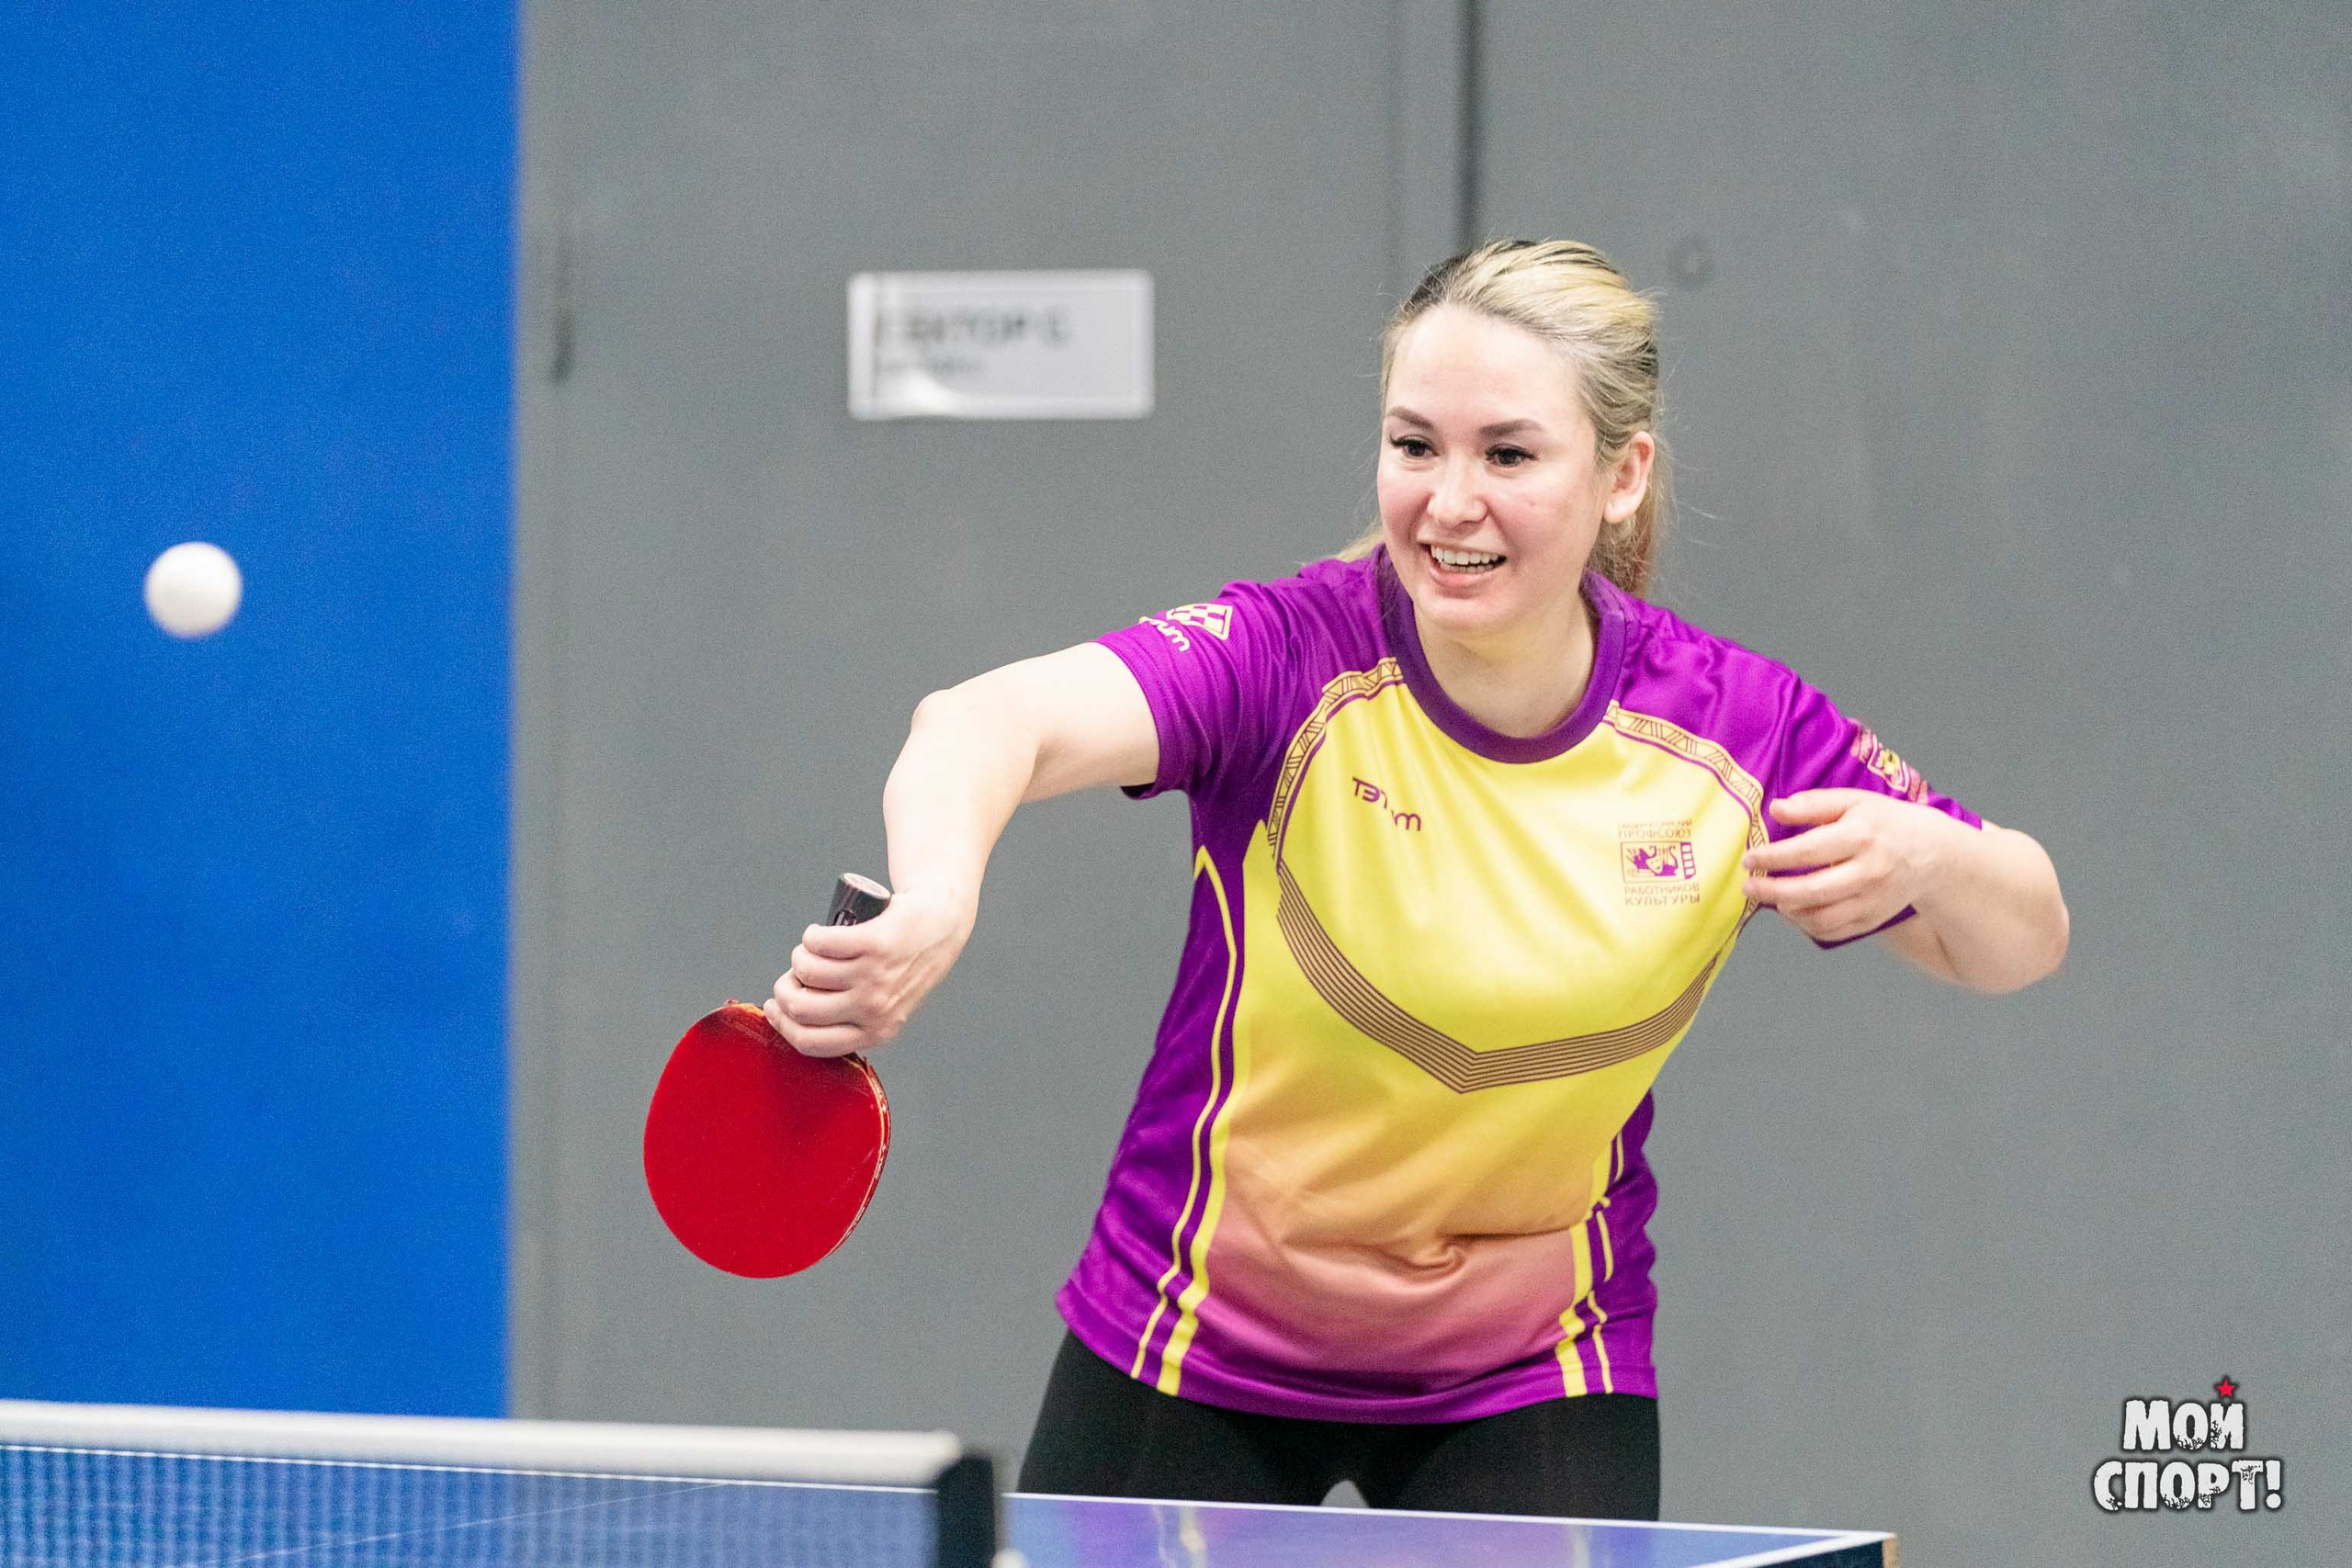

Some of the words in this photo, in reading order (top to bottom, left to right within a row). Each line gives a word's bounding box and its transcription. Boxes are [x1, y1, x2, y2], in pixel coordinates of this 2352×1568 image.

[1618, 828, 1691, 840] ПРОФСОЮЗ
[1624, 883, 1701, 896] РАБОТНИКОВ
[1624, 893, 1701, 907] КУЛЬТУРЫ
